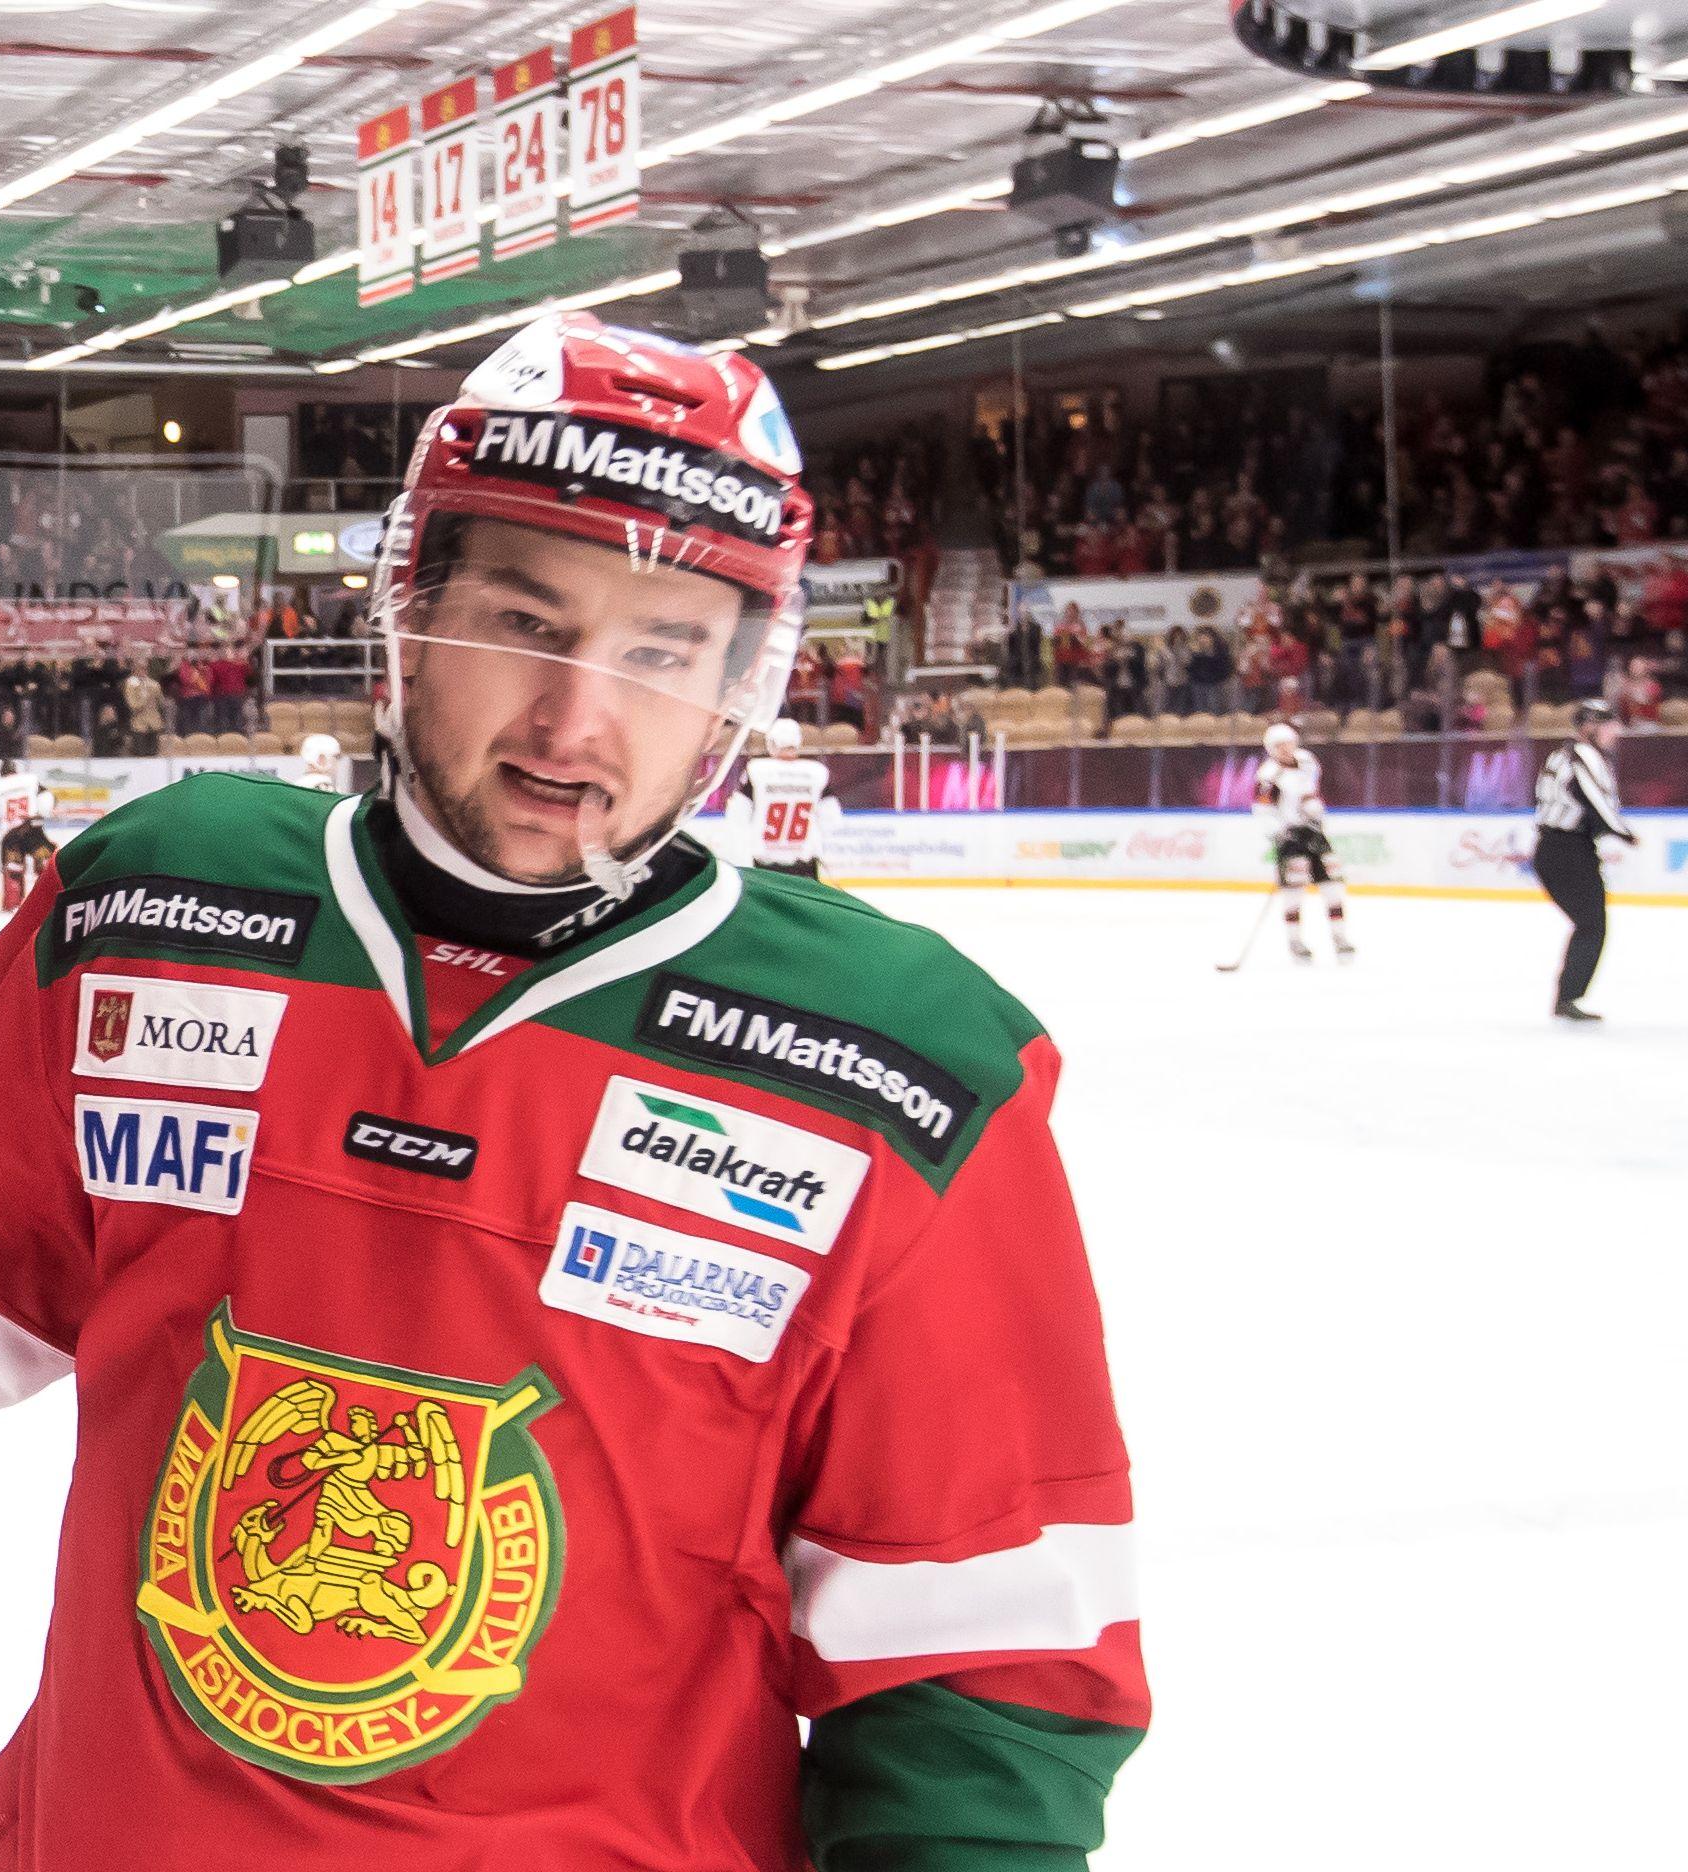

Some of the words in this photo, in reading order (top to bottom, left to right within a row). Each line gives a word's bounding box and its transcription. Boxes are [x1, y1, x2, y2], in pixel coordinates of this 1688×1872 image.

[503, 112, 546, 194] 24
[580, 78, 626, 163] 78
[370, 171, 398, 244] 14
[432, 143, 464, 219] 17
[763, 802, 812, 841] 96
[425, 943, 508, 977] SHL
[136, 1014, 260, 1058] MORA
[349, 1122, 474, 1167] CCM
[621, 1120, 826, 1211] dalakraft
[621, 1242, 789, 1311] DALARNAS
[156, 1431, 204, 1580] MORA
[468, 1498, 535, 1665] KLUBB
[185, 1642, 441, 1757] ISHOCKEY-
